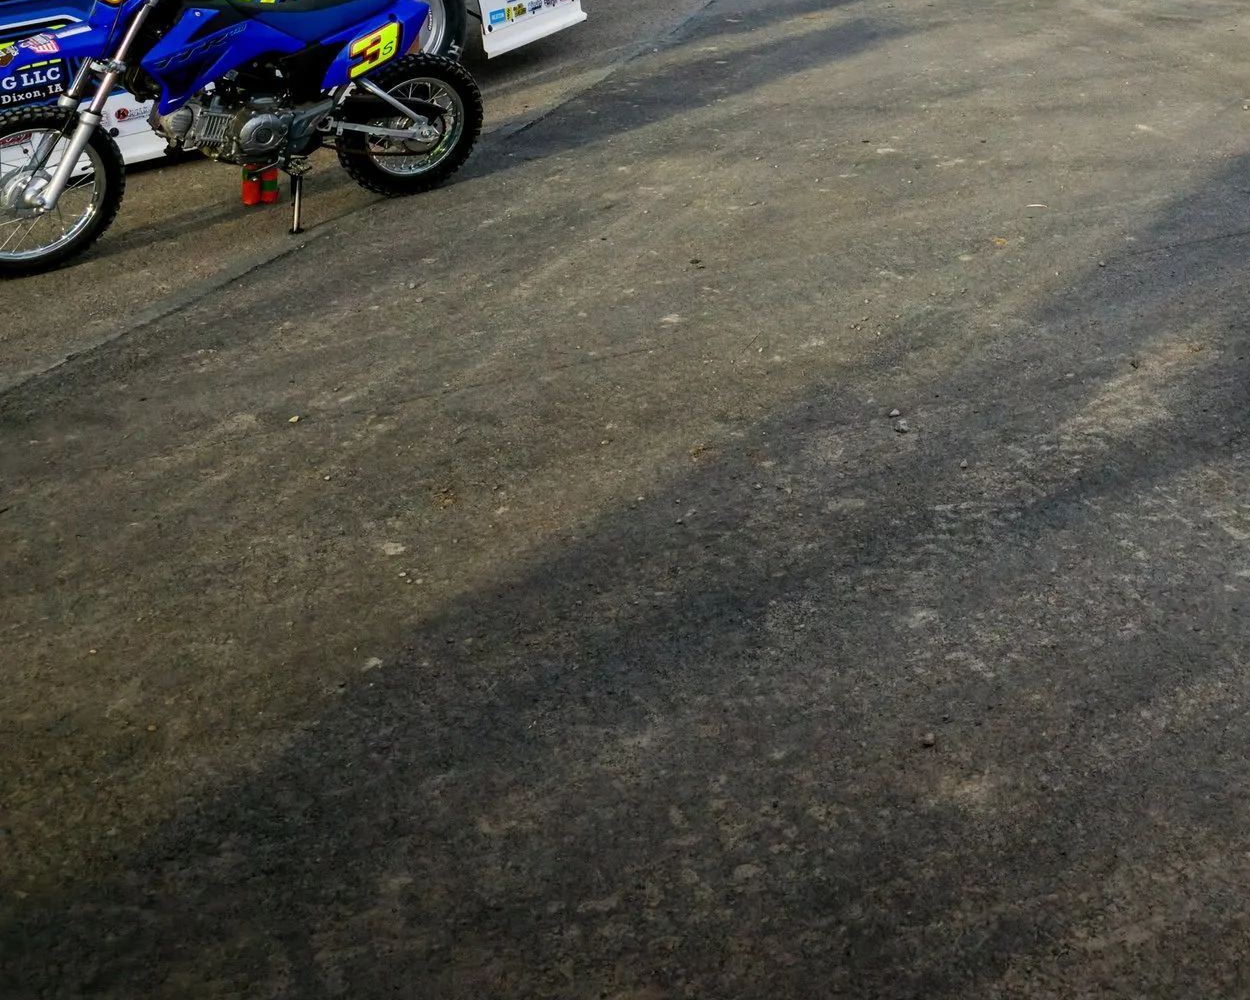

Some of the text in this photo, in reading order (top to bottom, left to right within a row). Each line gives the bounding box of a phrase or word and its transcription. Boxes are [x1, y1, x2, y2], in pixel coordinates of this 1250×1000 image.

[20, 67, 62, 87] LLC
[0, 83, 64, 105] Dixon, IA
